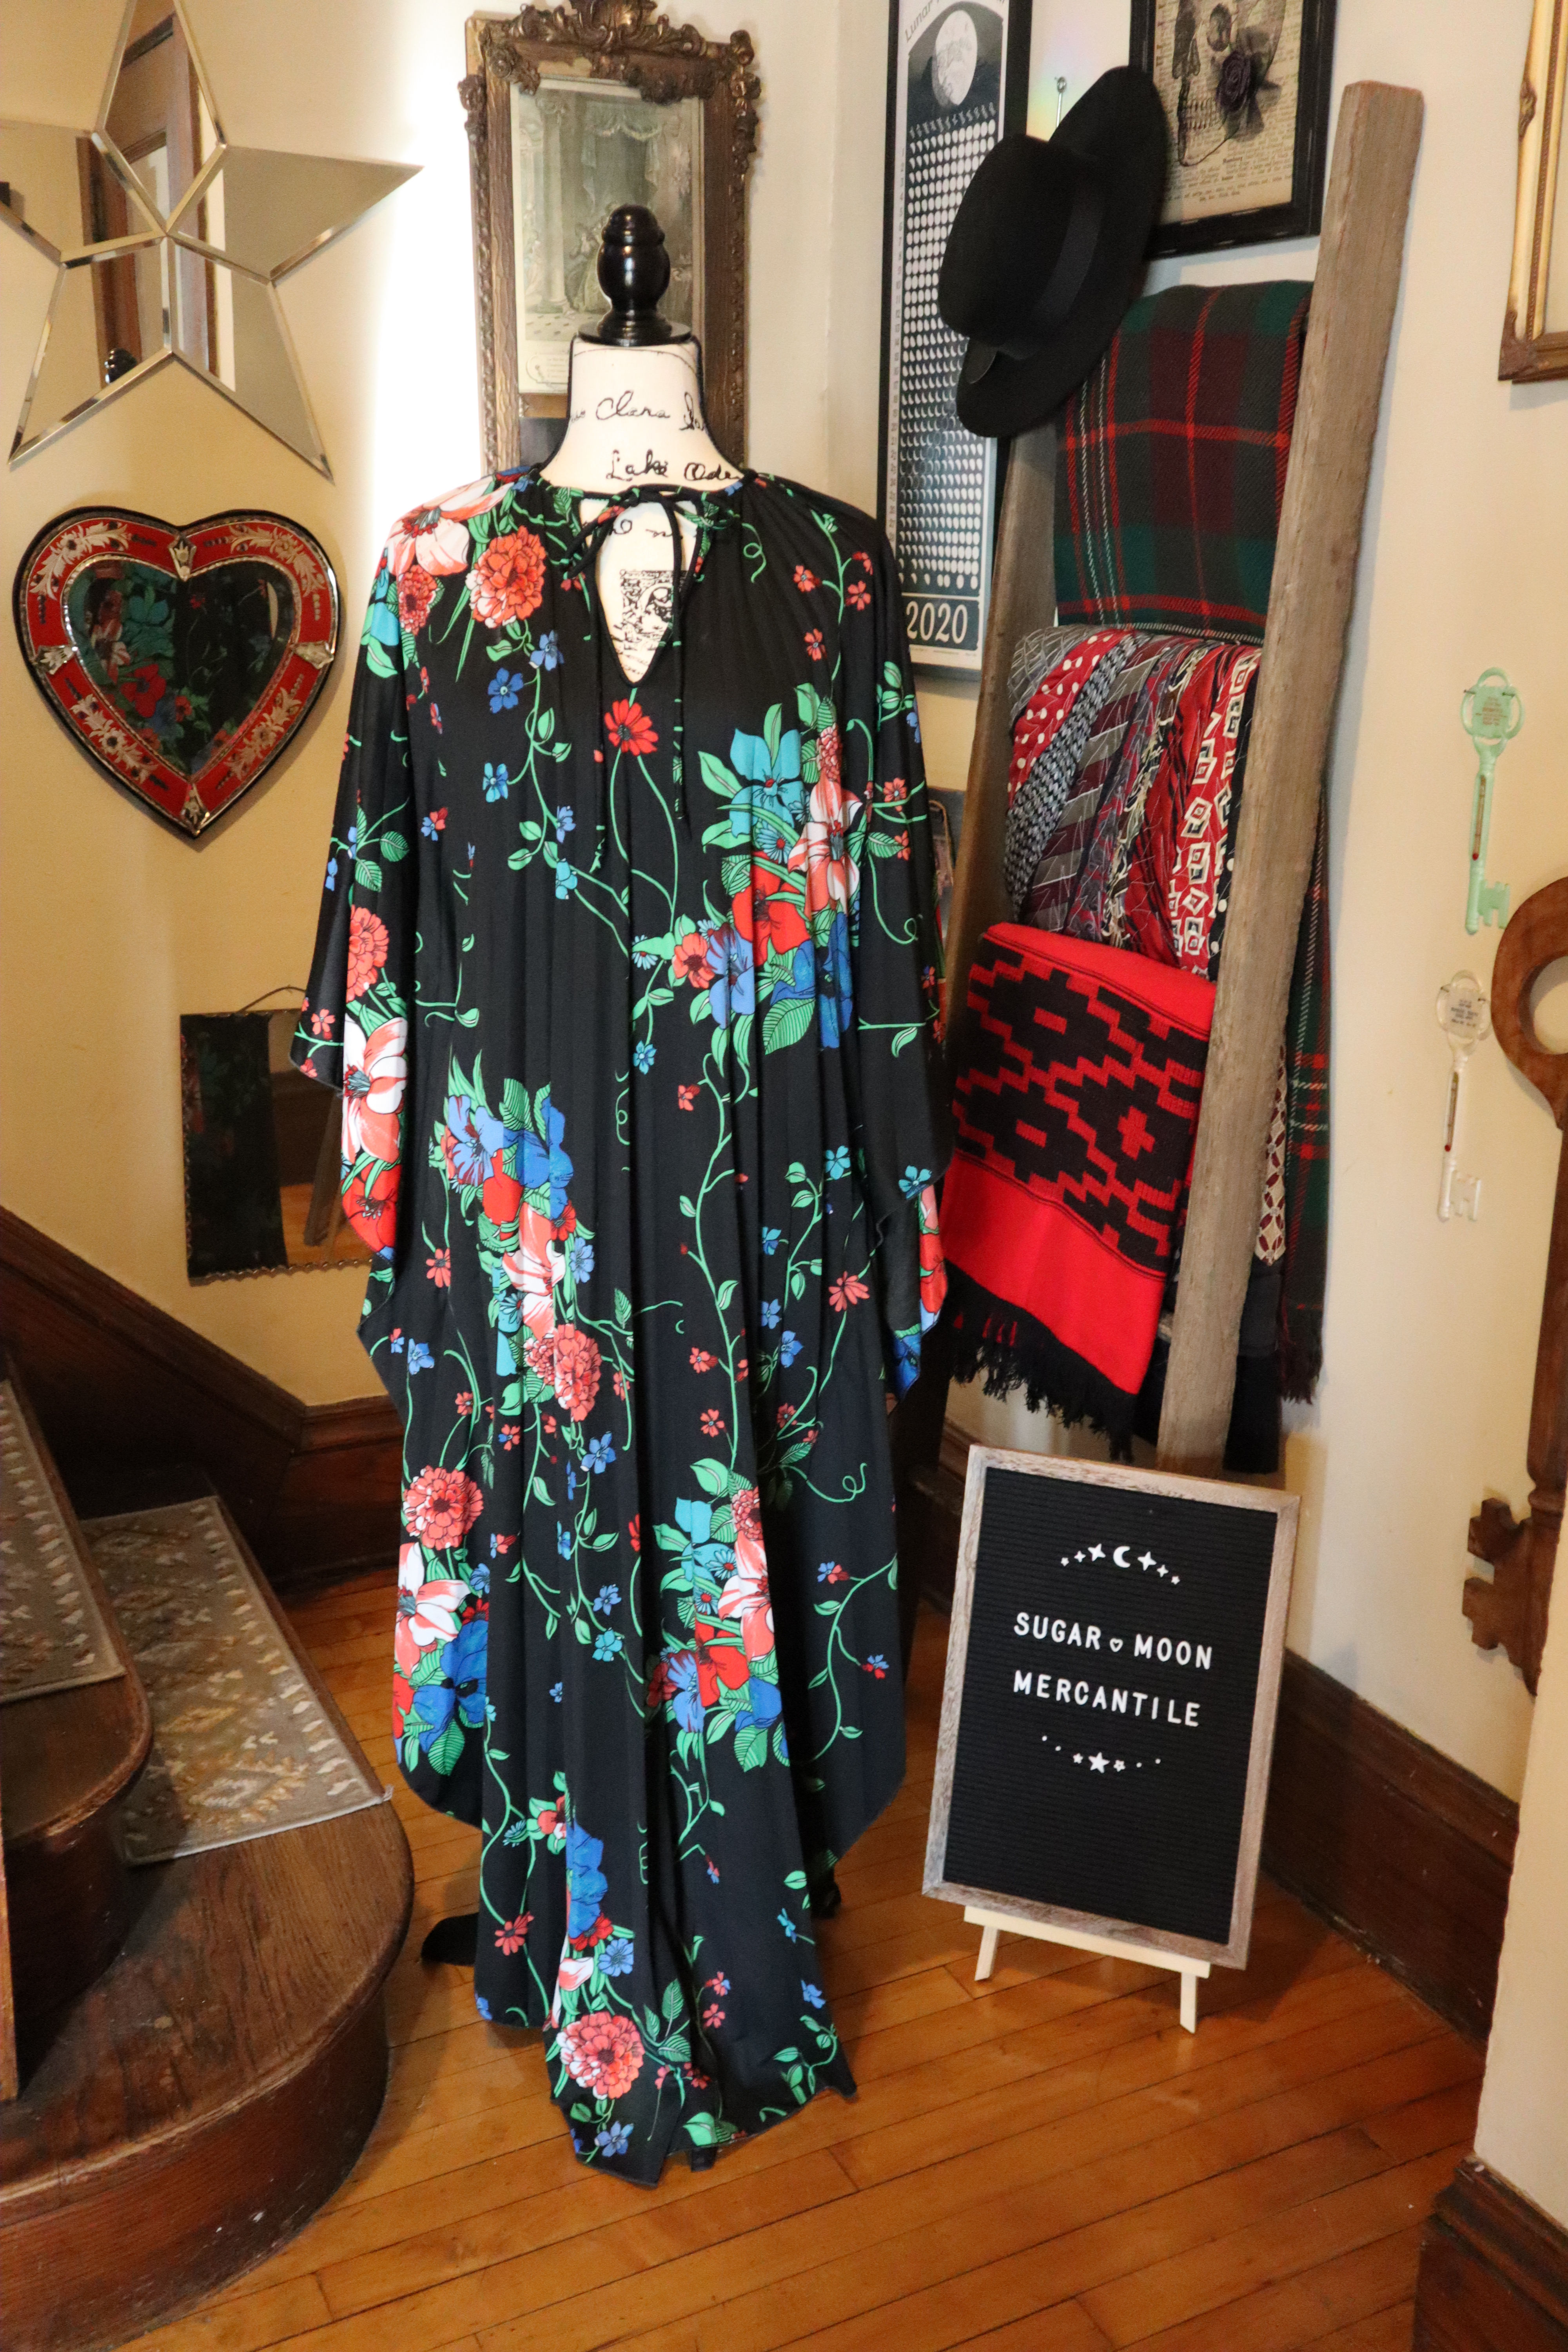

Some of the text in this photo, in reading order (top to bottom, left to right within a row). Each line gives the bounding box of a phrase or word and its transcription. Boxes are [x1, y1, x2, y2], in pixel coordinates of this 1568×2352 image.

[905, 0, 933, 43] Lunar
[906, 601, 968, 644] 2020
[1014, 1612, 1212, 1670] SUGAR MOON
[1013, 1670, 1201, 1727] MERCANTILE
